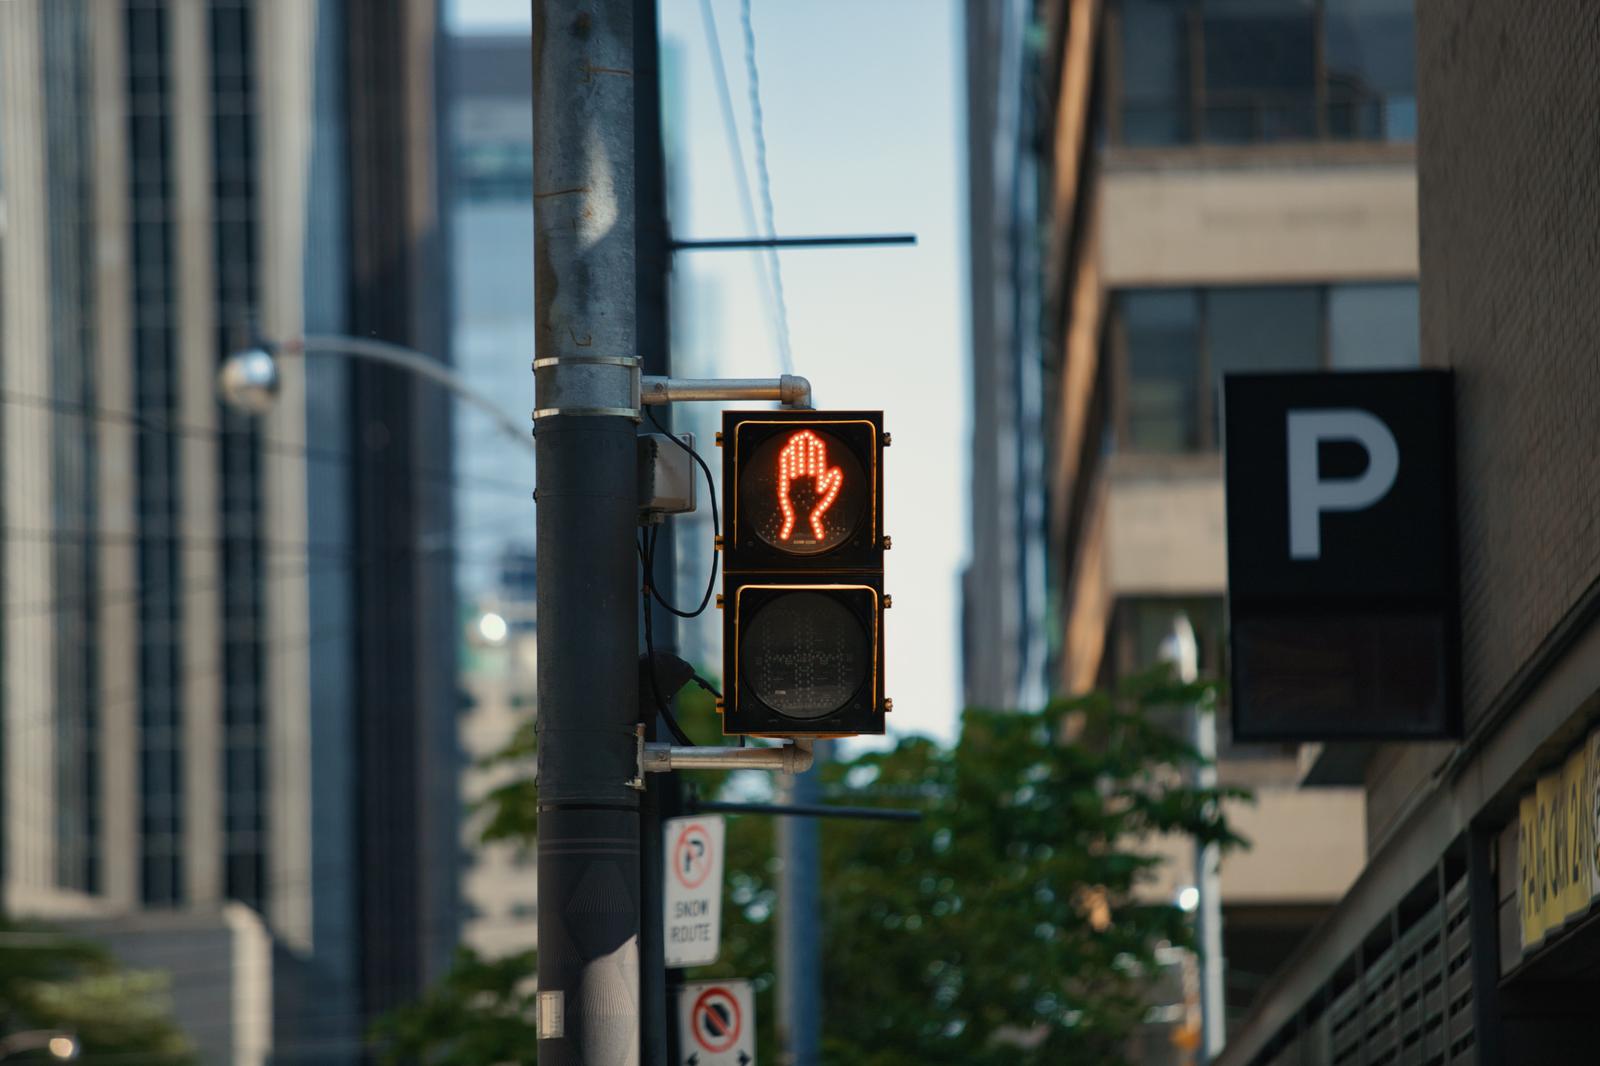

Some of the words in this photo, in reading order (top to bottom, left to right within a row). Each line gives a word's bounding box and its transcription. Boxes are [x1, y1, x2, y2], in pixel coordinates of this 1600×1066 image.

[1287, 408, 1399, 560] P
[674, 899, 709, 919] SNOW
[671, 922, 711, 942] ROUTE
